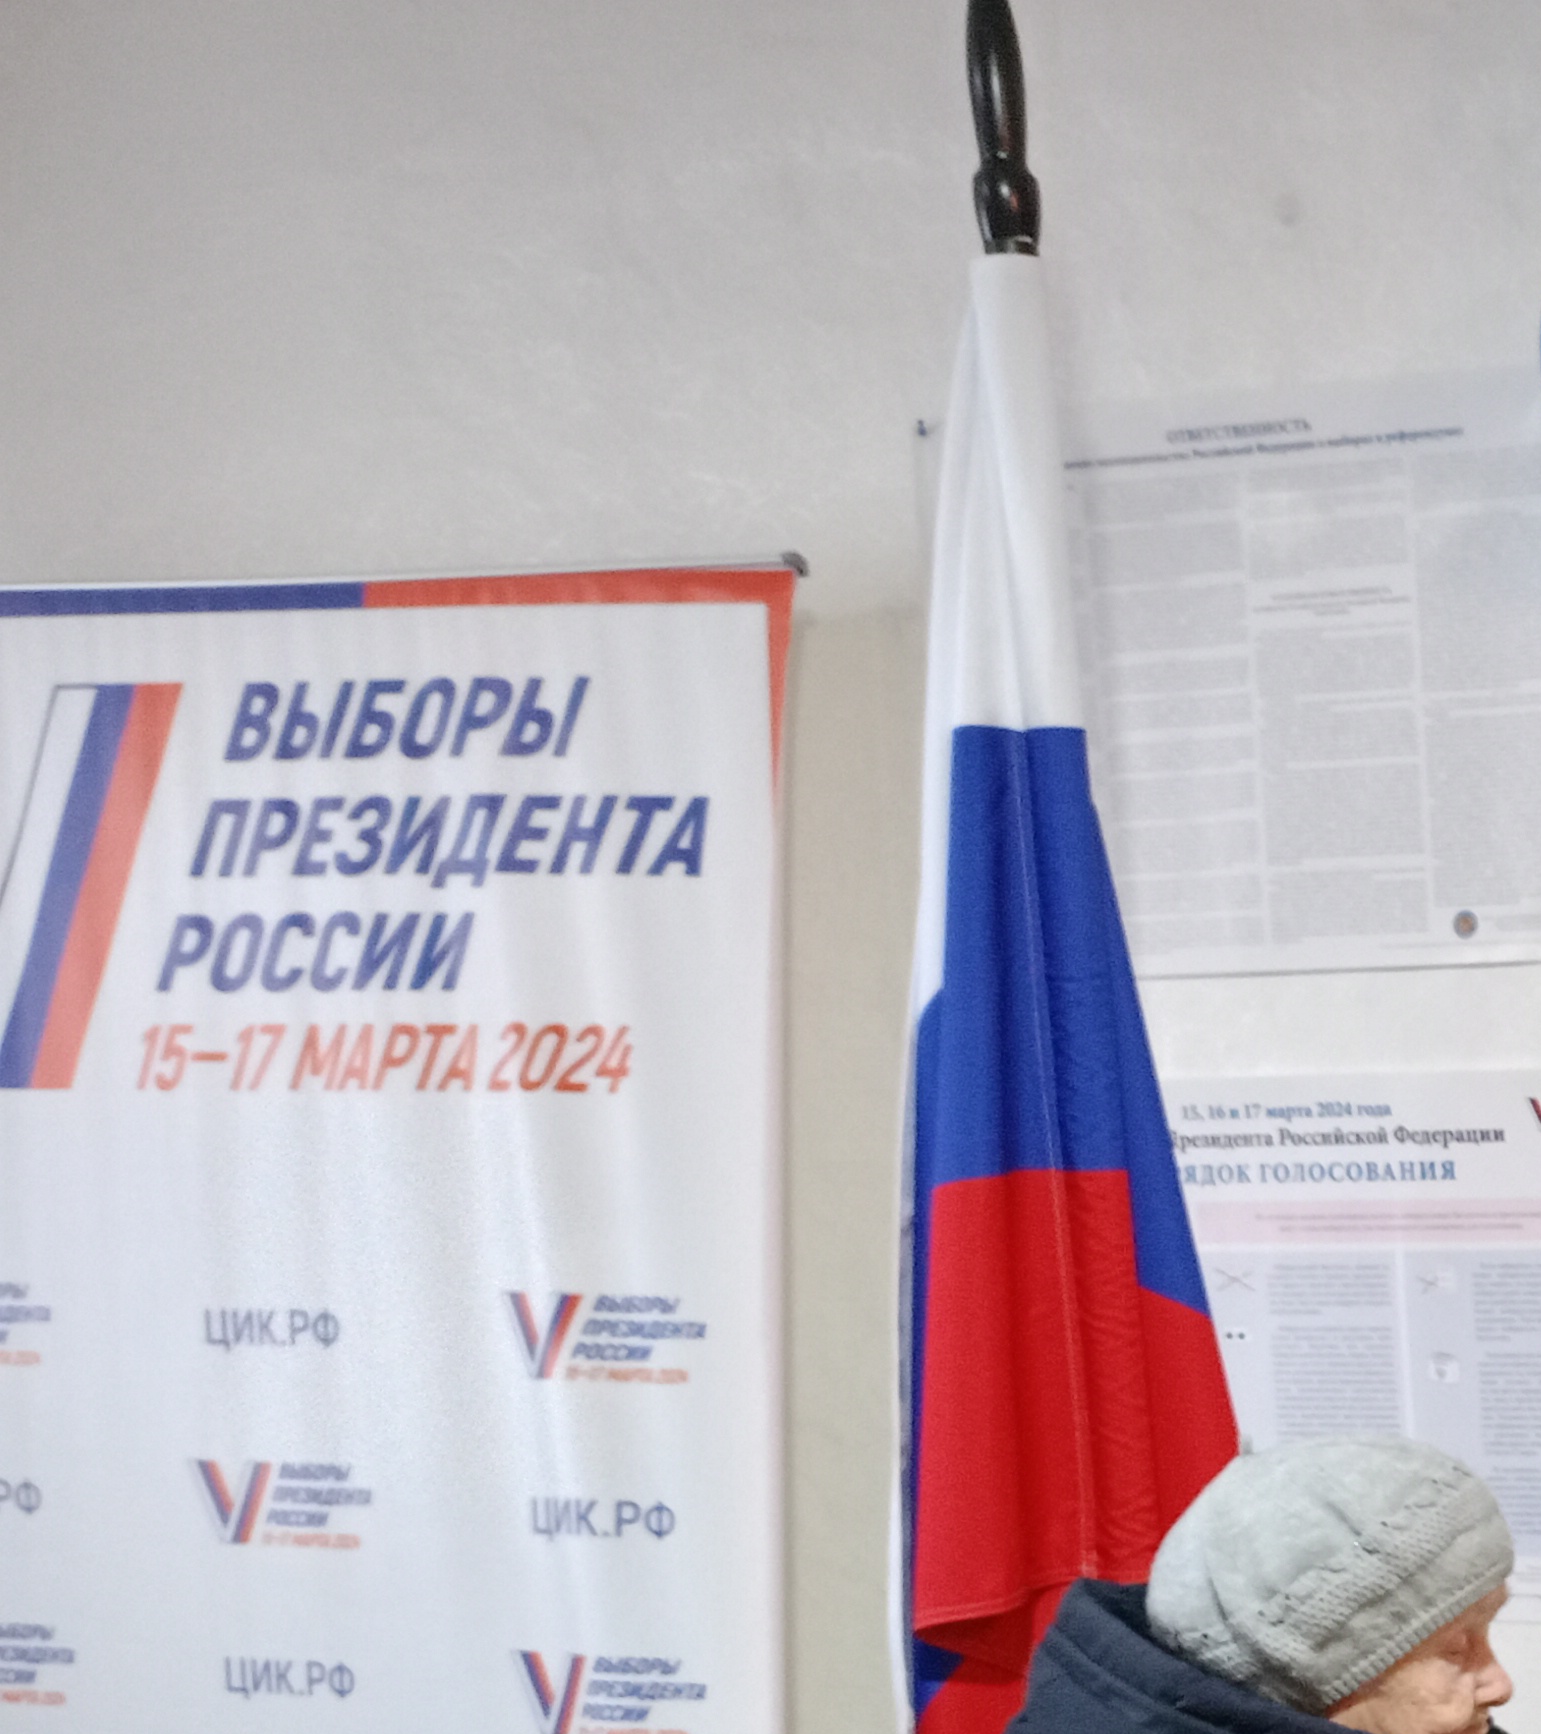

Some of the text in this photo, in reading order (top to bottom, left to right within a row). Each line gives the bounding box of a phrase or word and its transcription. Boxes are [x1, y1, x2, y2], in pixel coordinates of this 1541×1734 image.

[224, 676, 590, 762] ВЫБОРЫ
[190, 796, 711, 888] ПРЕЗИДЕНТА
[156, 911, 475, 993] РОССИИ
[290, 1024, 480, 1092] МАРТА
[488, 1024, 635, 1094] 2024
